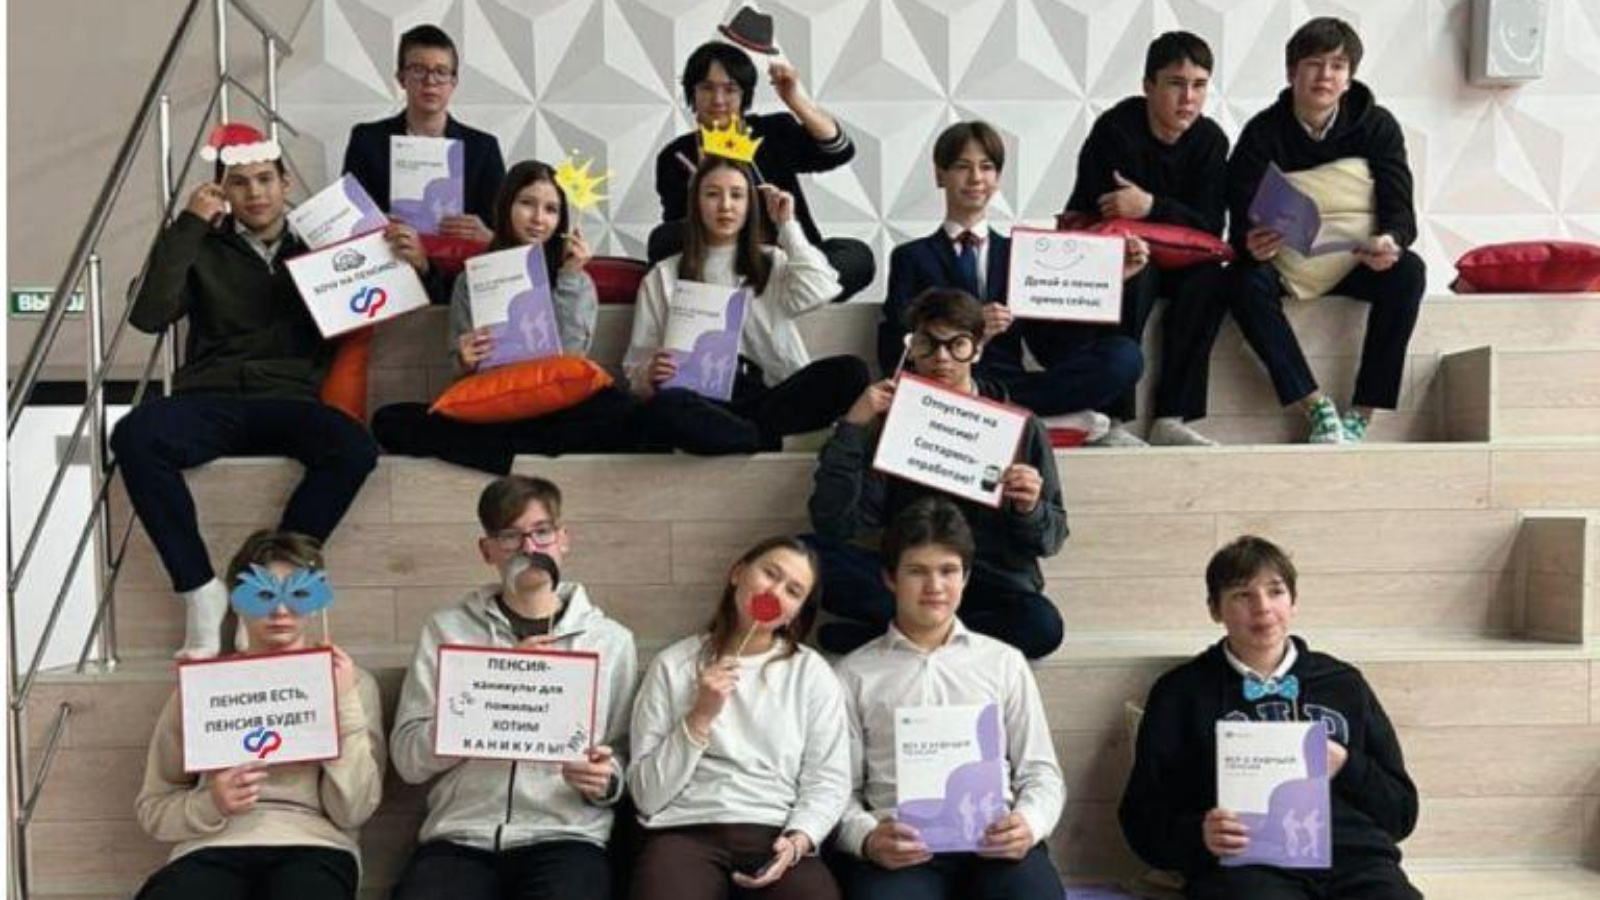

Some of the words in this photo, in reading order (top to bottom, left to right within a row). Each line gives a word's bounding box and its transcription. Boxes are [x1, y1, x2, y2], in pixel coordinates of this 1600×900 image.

[1062, 279, 1069, 288] о
[921, 395, 981, 422] Отпустите
[983, 416, 998, 428] на
[487, 658, 552, 672] ПЕНСИЯ-
[472, 680, 537, 695] каникулы
[539, 685, 564, 695] для
[210, 691, 267, 709] ПЕНСИЯ
[270, 686, 308, 703] ЕСТЬ,
[485, 701, 550, 714] пожилых!
[204, 716, 263, 733] ПЕНСИЯ
[266, 710, 317, 728] БУДЕТ!
[493, 720, 540, 732] ХОТИМ
